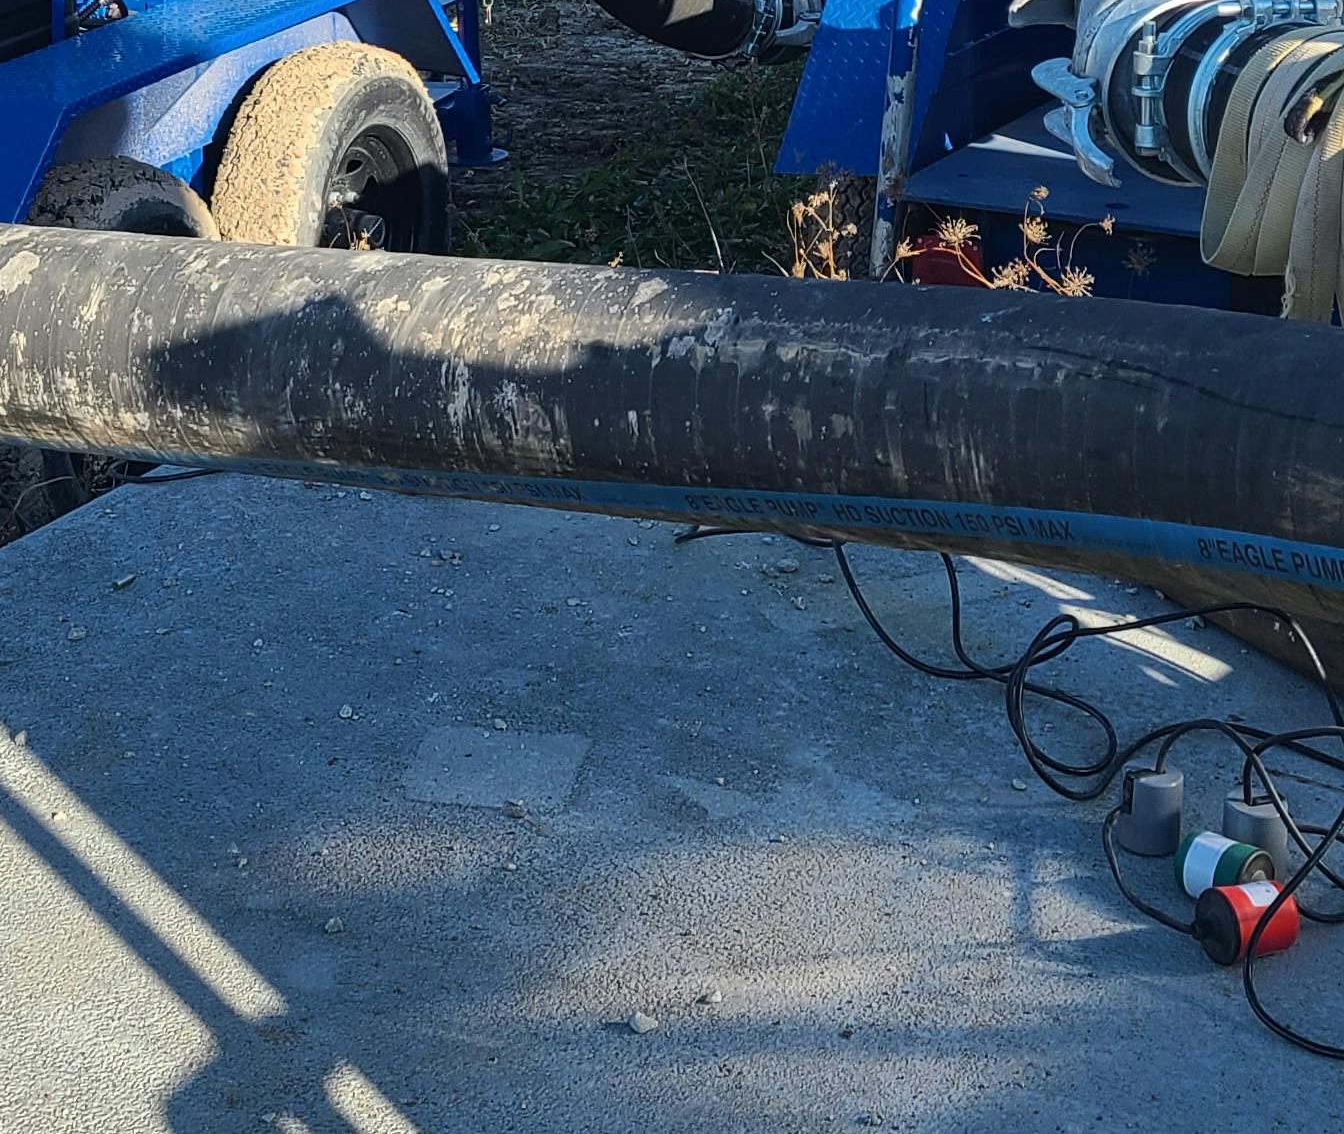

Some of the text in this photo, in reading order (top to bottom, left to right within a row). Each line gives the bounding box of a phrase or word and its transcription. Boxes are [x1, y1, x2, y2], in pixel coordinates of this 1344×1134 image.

[831, 502, 861, 523] HD
[860, 504, 955, 530] SUCTION
[955, 514, 989, 534] 150
[989, 517, 1026, 538] PSI
[1029, 519, 1075, 541] MAX
